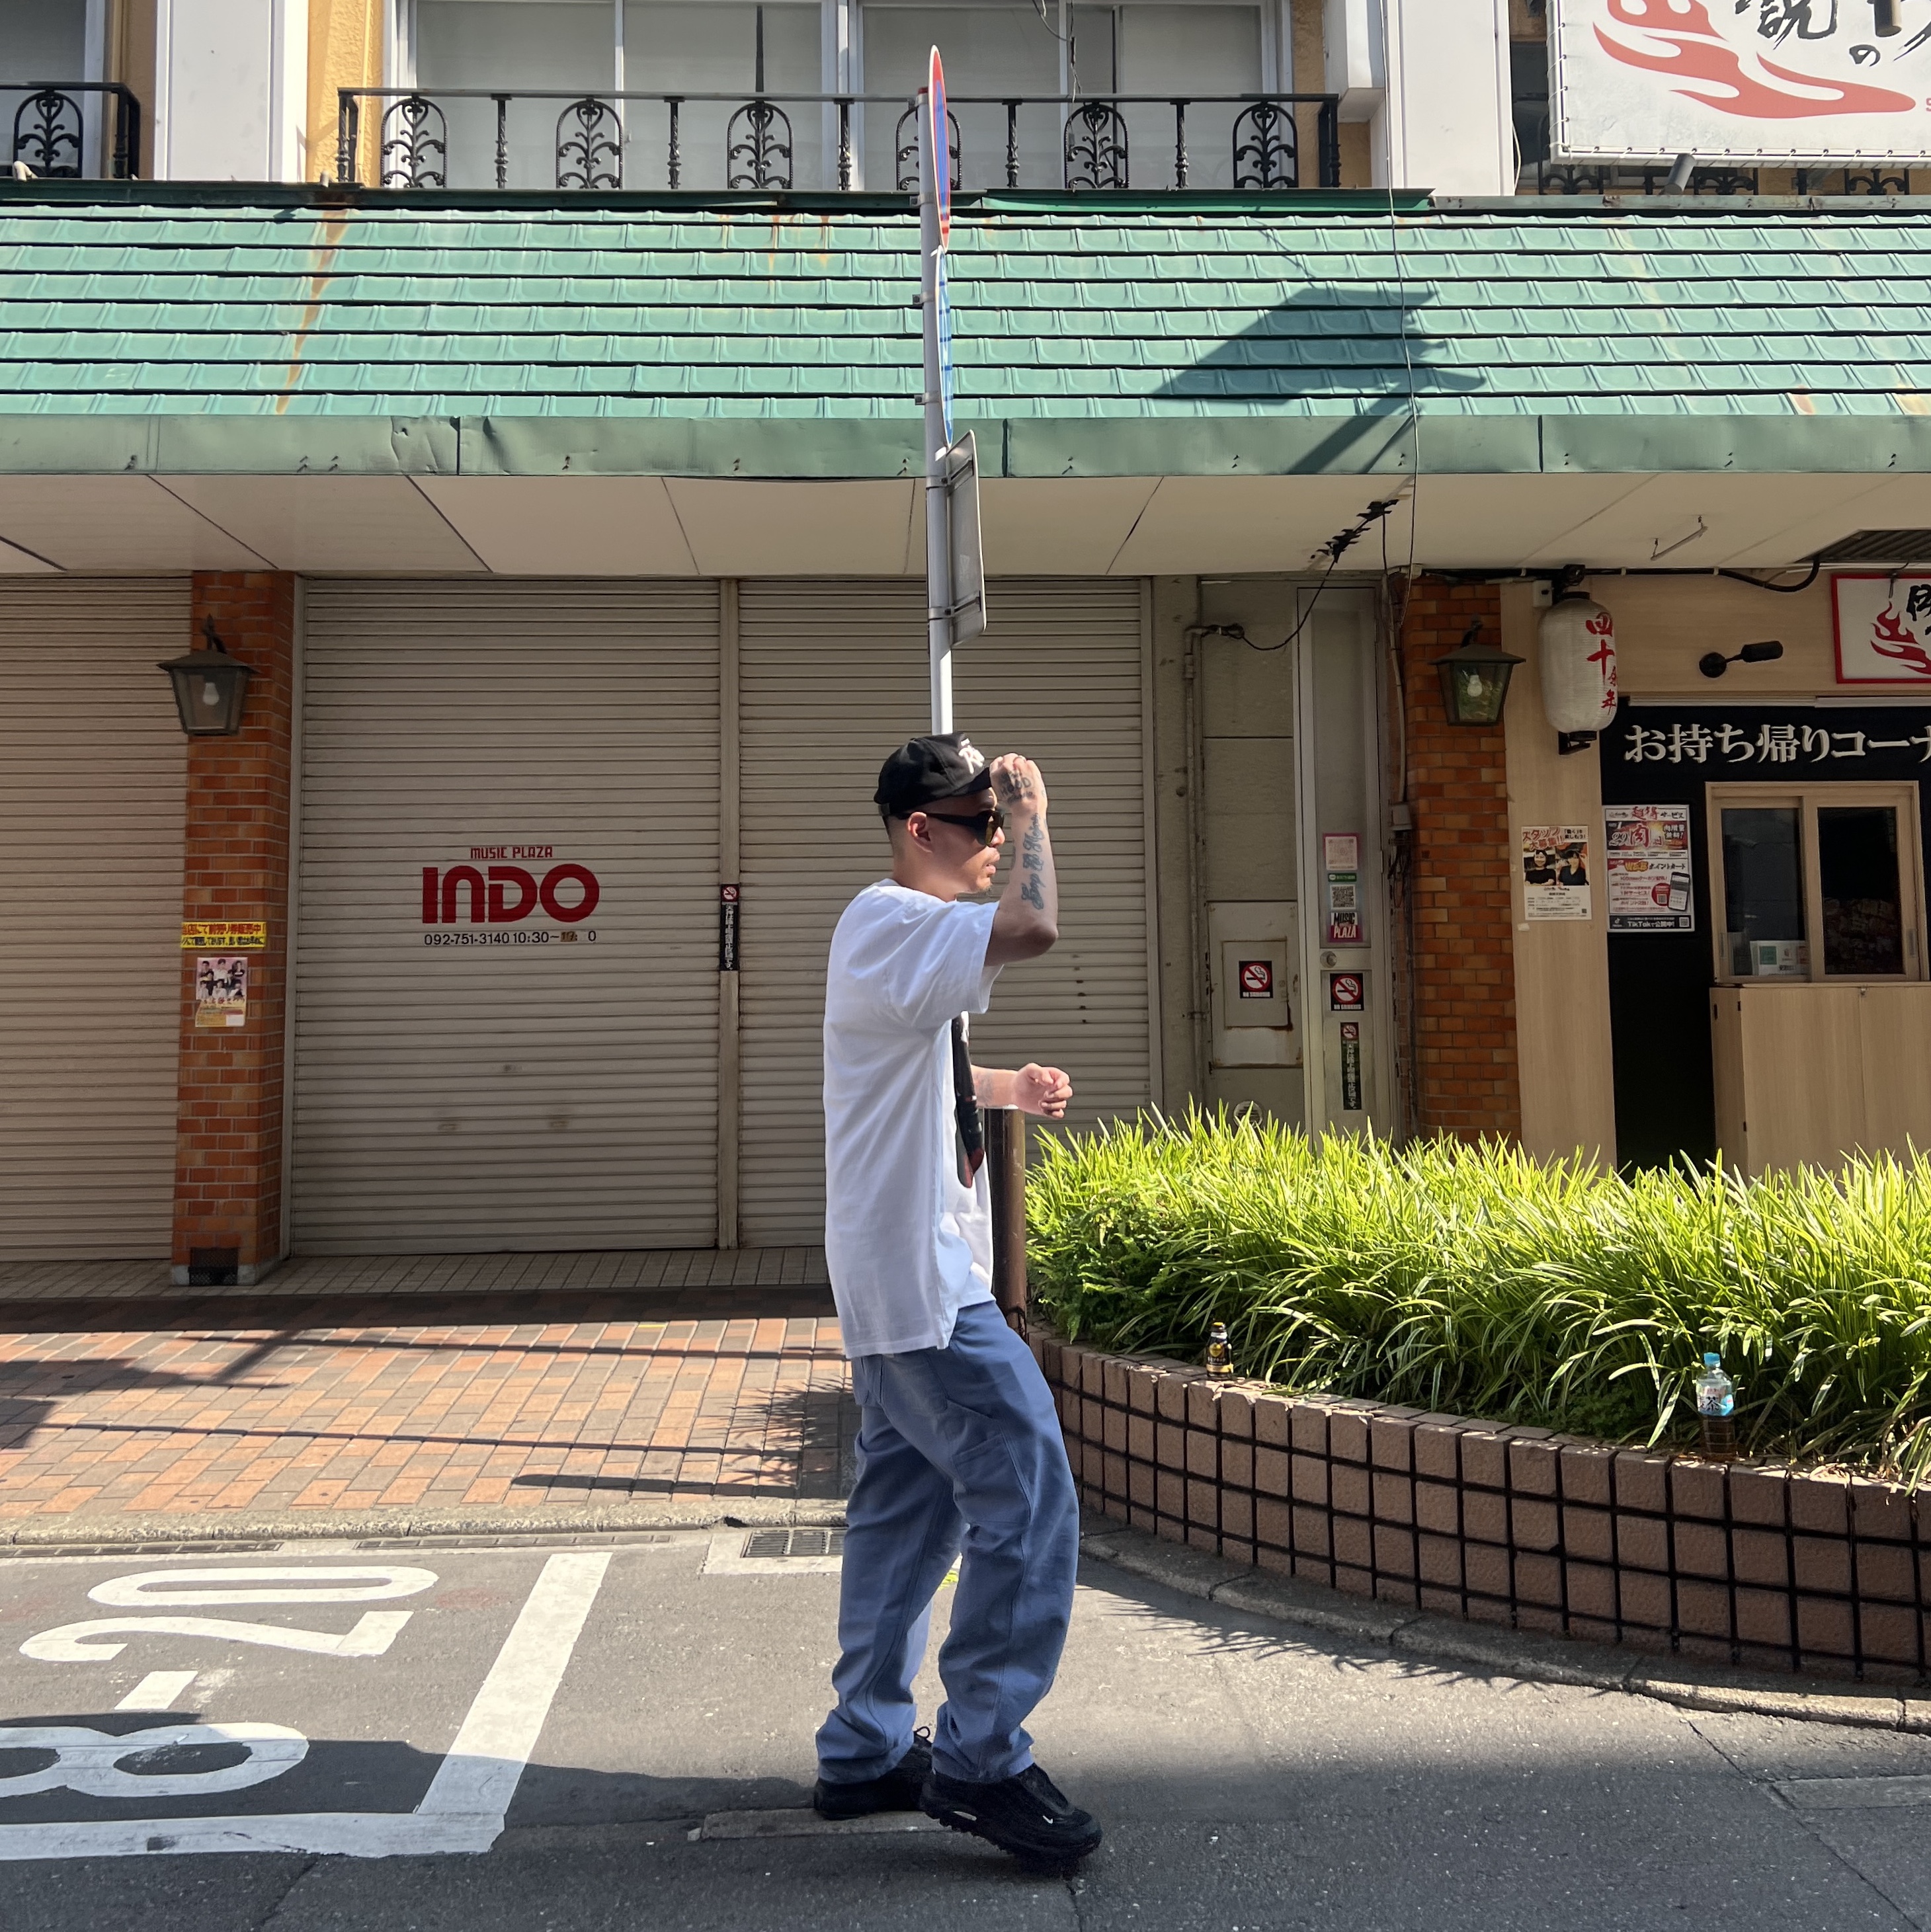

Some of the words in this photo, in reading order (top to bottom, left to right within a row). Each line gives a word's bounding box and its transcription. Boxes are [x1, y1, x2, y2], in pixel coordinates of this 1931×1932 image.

[470, 846, 508, 859] MUSIC
[512, 846, 553, 858] PLAZA
[422, 864, 600, 924] INDO
[1333, 912, 1355, 926] MUSIC
[424, 932, 510, 945] 092-751-3140
[1333, 926, 1356, 939] PLAZA
